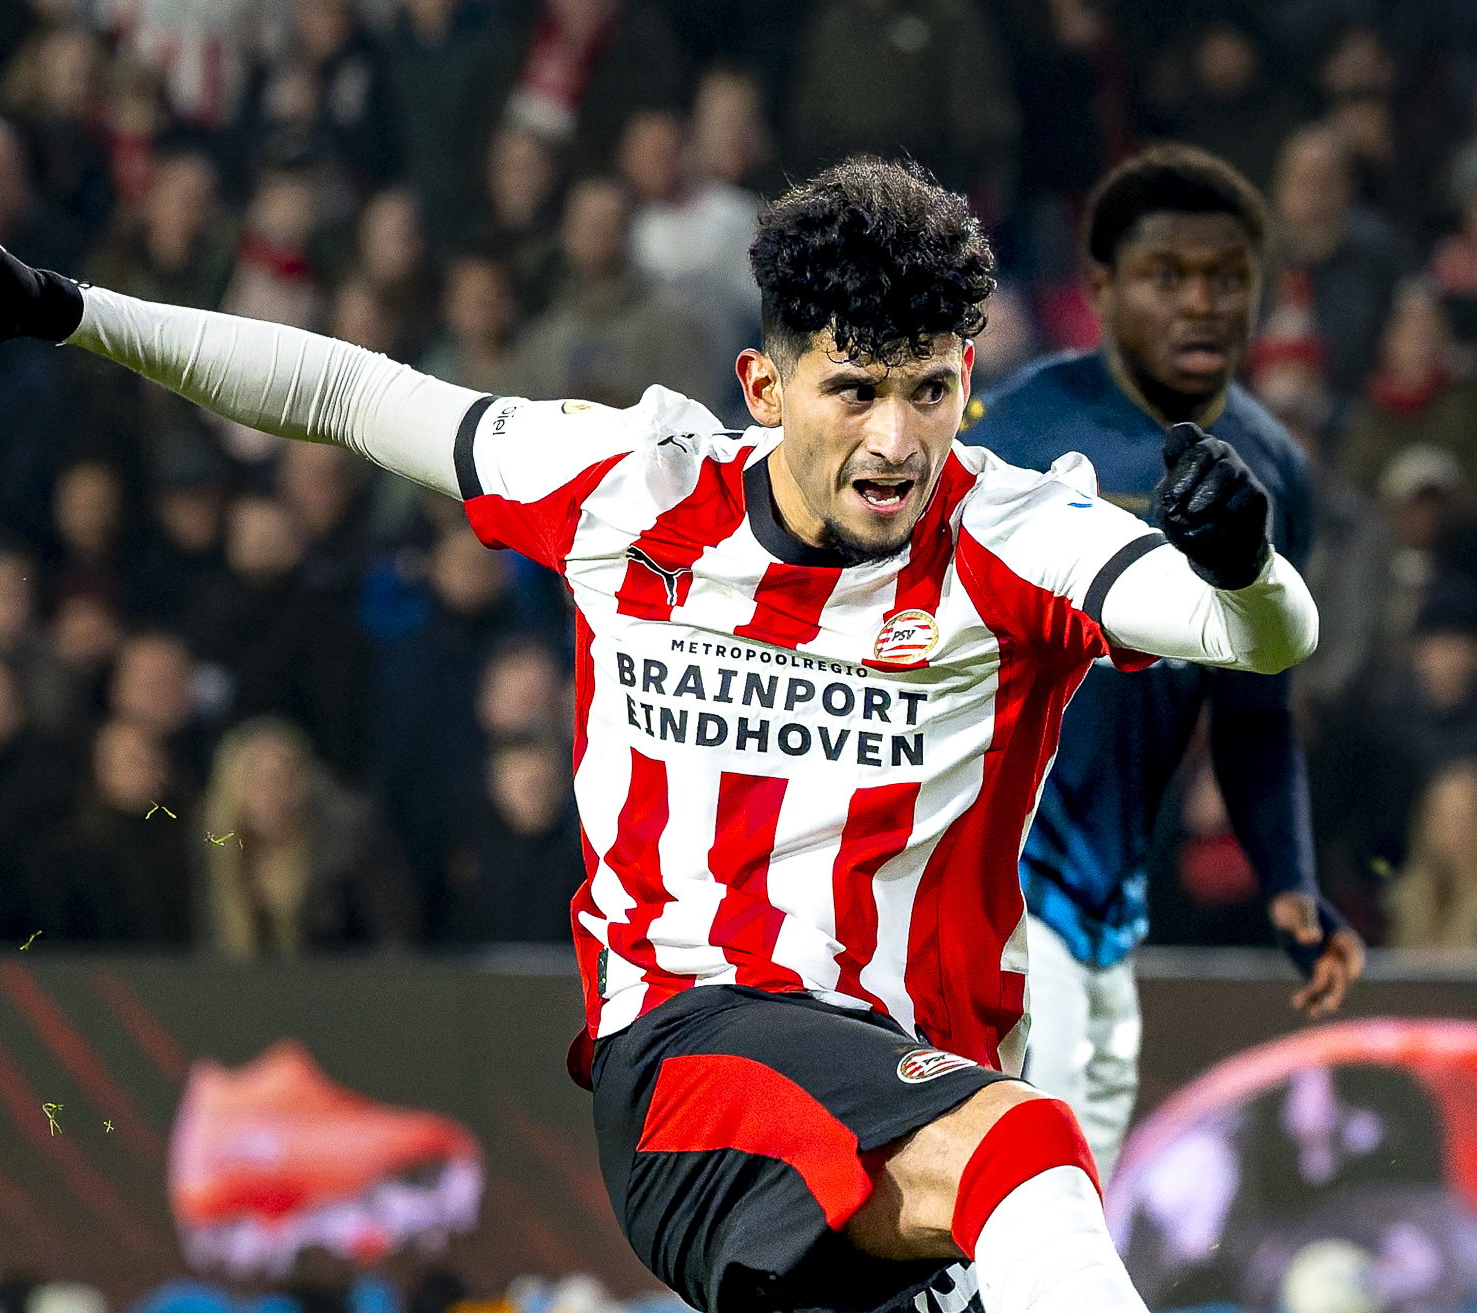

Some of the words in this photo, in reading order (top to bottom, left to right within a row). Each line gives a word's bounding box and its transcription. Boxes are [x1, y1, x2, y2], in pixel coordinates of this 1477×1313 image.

[616, 651, 928, 726] BRAINPORT
[670, 639, 868, 678] METROPOOLREGIO
[625, 692, 924, 767] EINDHOVEN
